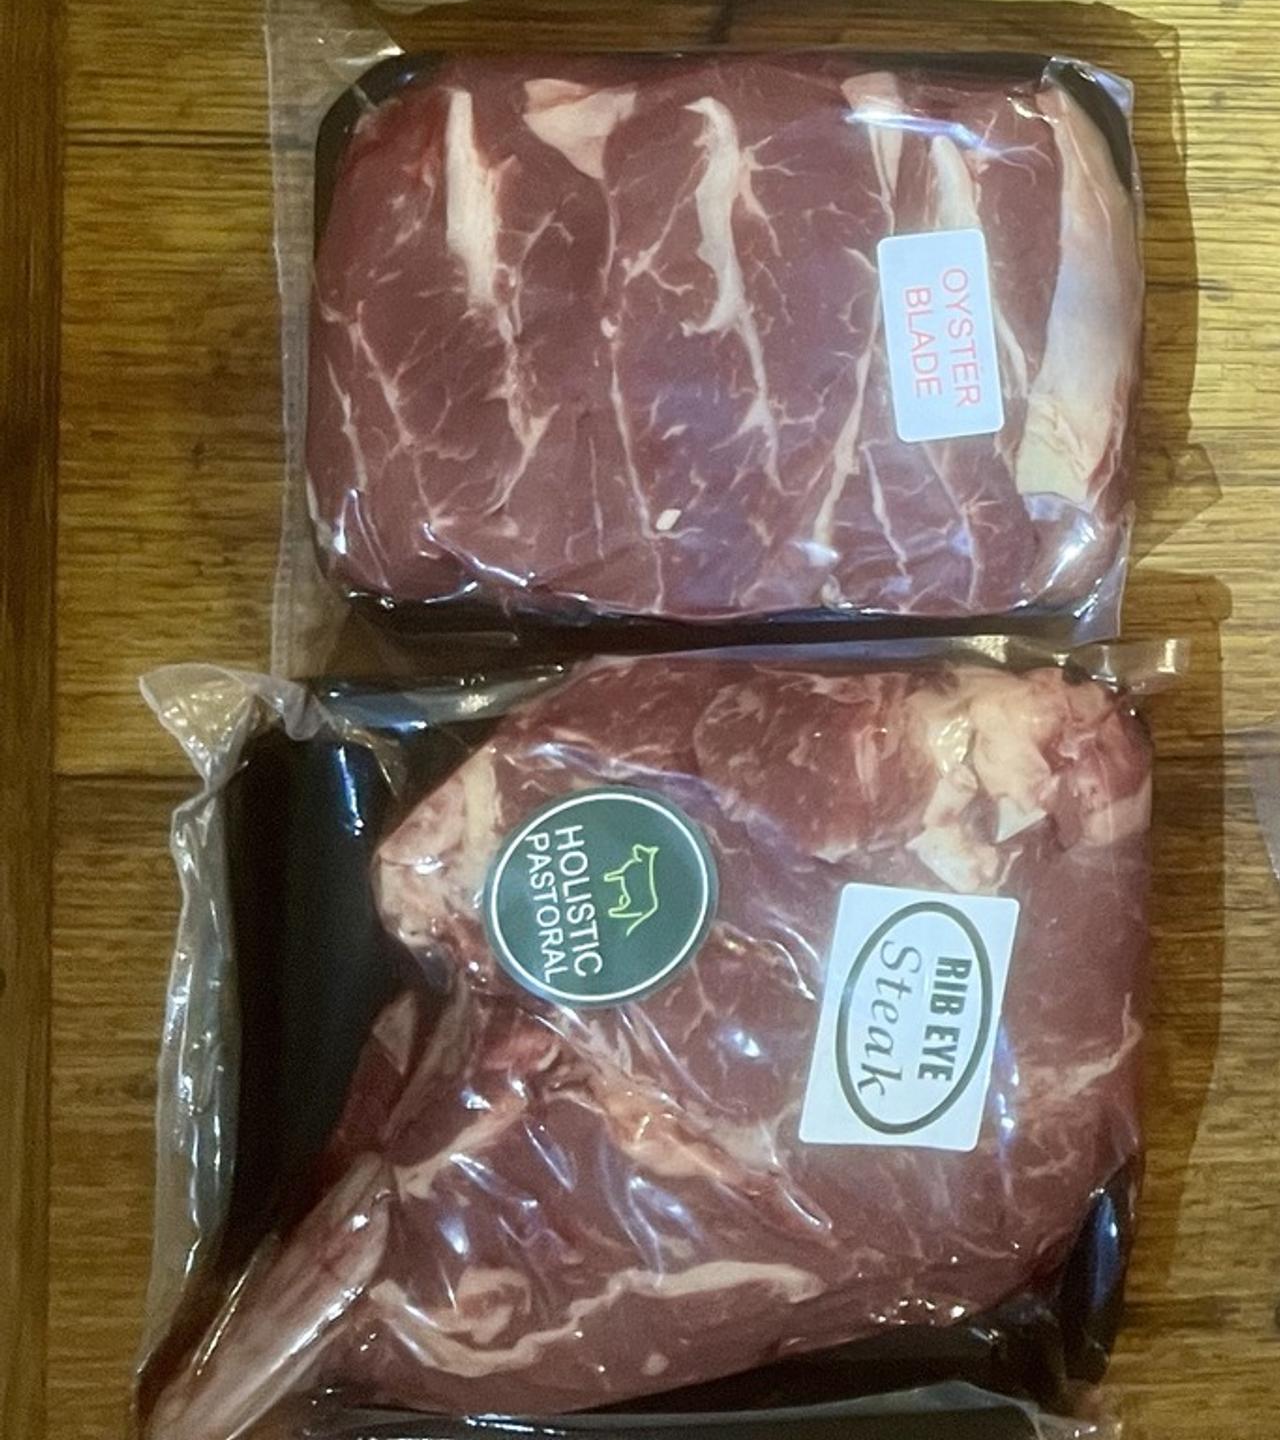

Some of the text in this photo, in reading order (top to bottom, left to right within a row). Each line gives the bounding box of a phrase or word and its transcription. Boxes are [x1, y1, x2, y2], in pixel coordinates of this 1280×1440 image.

[904, 287, 942, 399] BLADE
[942, 268, 981, 407] OYSTER
[525, 832, 568, 983] PASTORAL
[554, 824, 603, 977] HOLISTIC
[857, 940, 922, 1097] Steak
[917, 956, 973, 1082] RIB EYE
